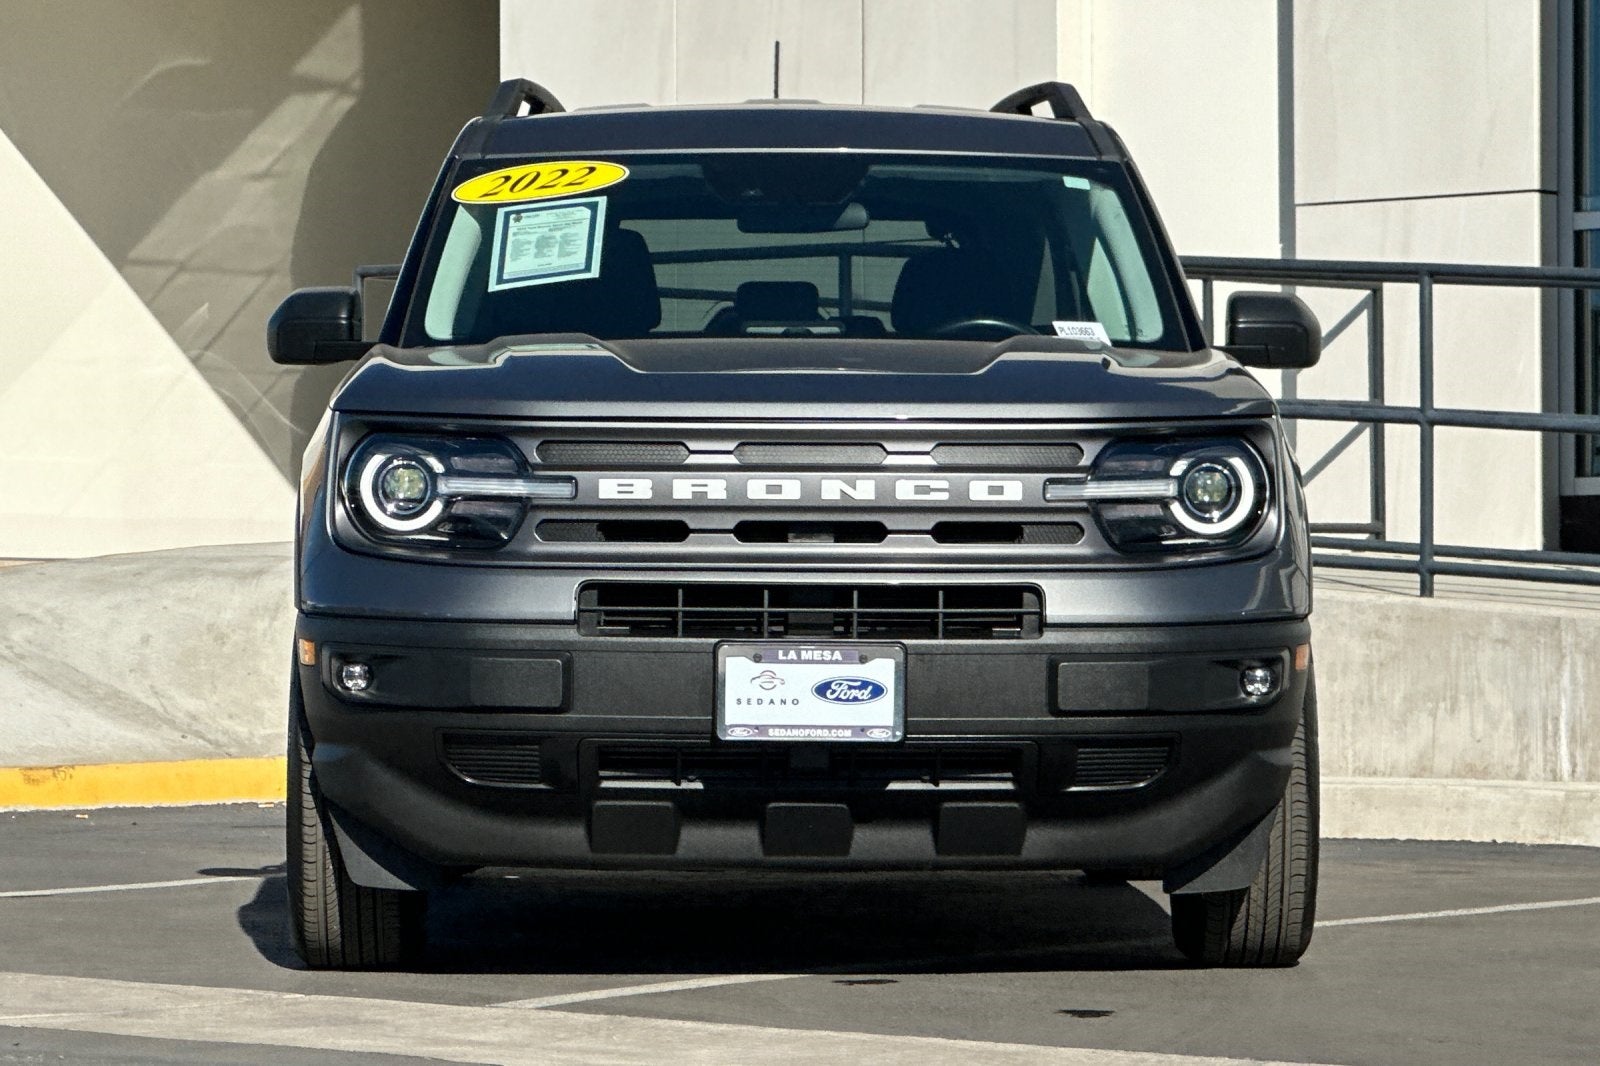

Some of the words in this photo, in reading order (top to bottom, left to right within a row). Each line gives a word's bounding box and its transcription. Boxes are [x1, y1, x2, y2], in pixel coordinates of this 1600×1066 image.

[478, 166, 597, 199] 2022
[598, 478, 1023, 501] BRONCO
[778, 650, 797, 660] LA
[800, 650, 843, 661] MESA
[826, 680, 872, 701] Ford
[736, 697, 800, 706] SEDANO
[768, 728, 852, 737] SEDANOFORD.COM
